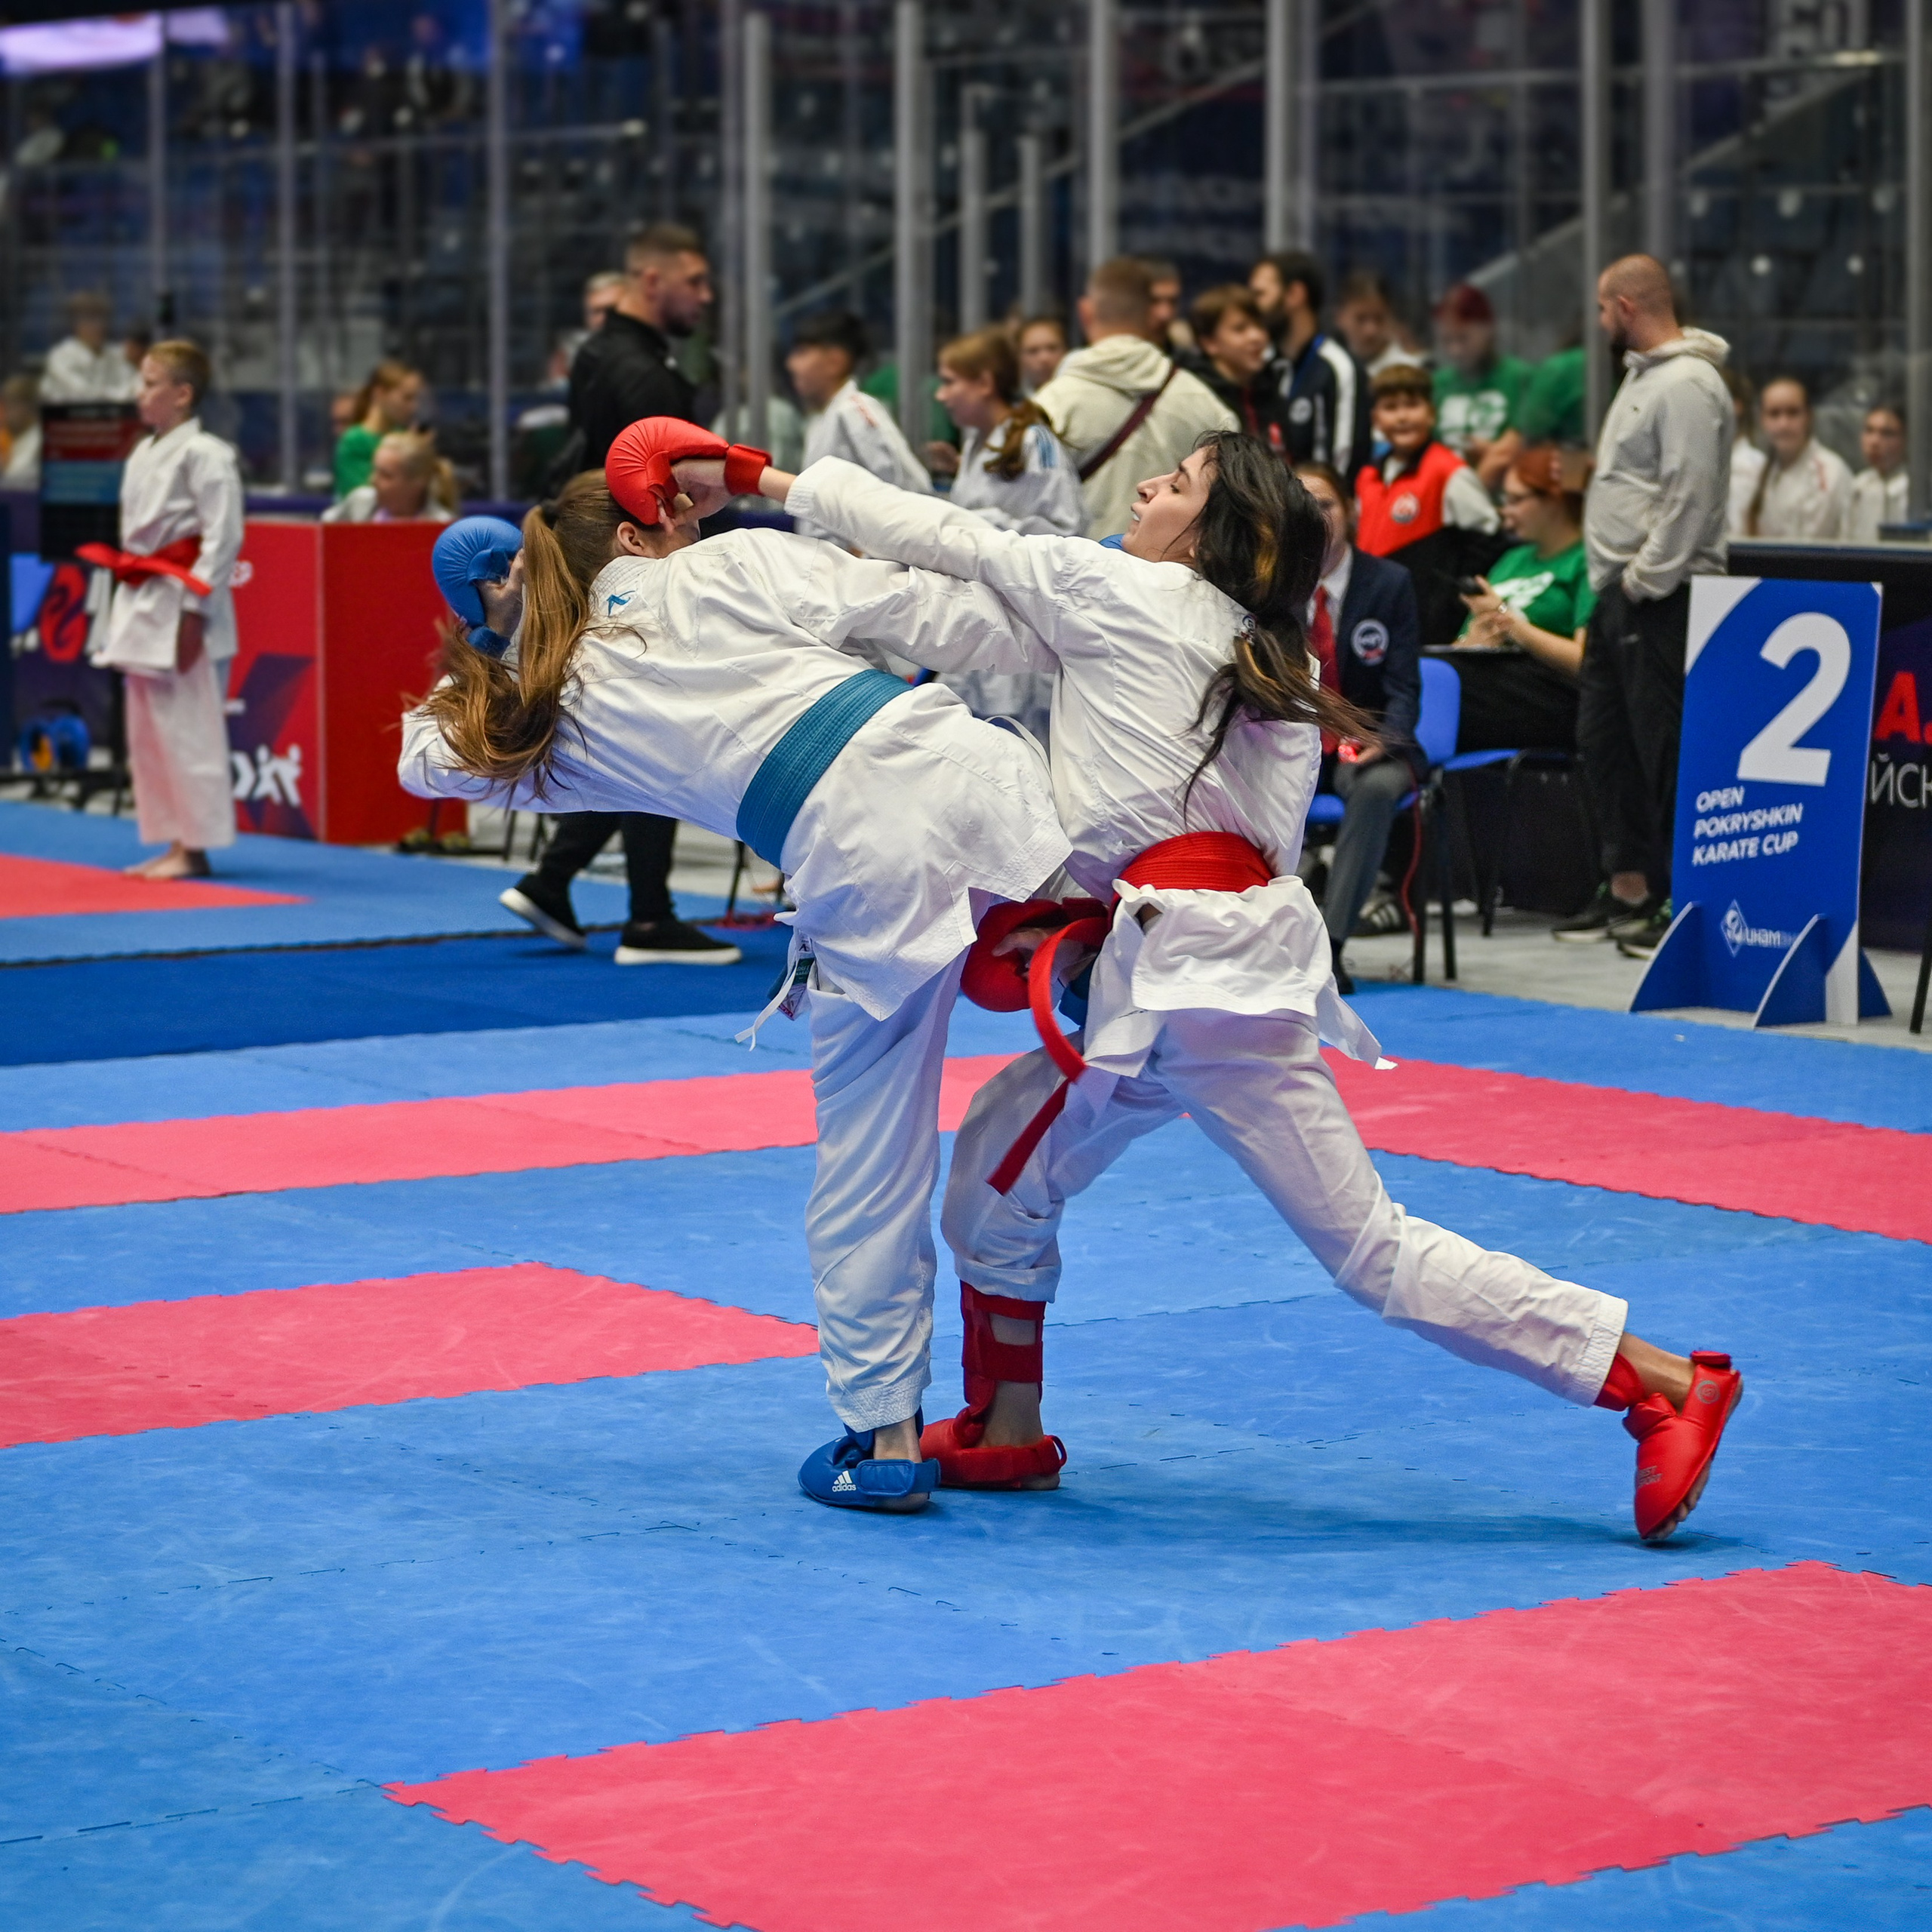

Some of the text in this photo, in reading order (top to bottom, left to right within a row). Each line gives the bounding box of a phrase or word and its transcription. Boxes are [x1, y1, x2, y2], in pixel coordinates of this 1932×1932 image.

[1737, 611, 1851, 786] 2
[1696, 786, 1745, 814] OPEN
[1694, 802, 1803, 840] POKRYSHKIN
[1692, 830, 1798, 866] KARATE CUP
[832, 1483, 857, 1492] adidas
